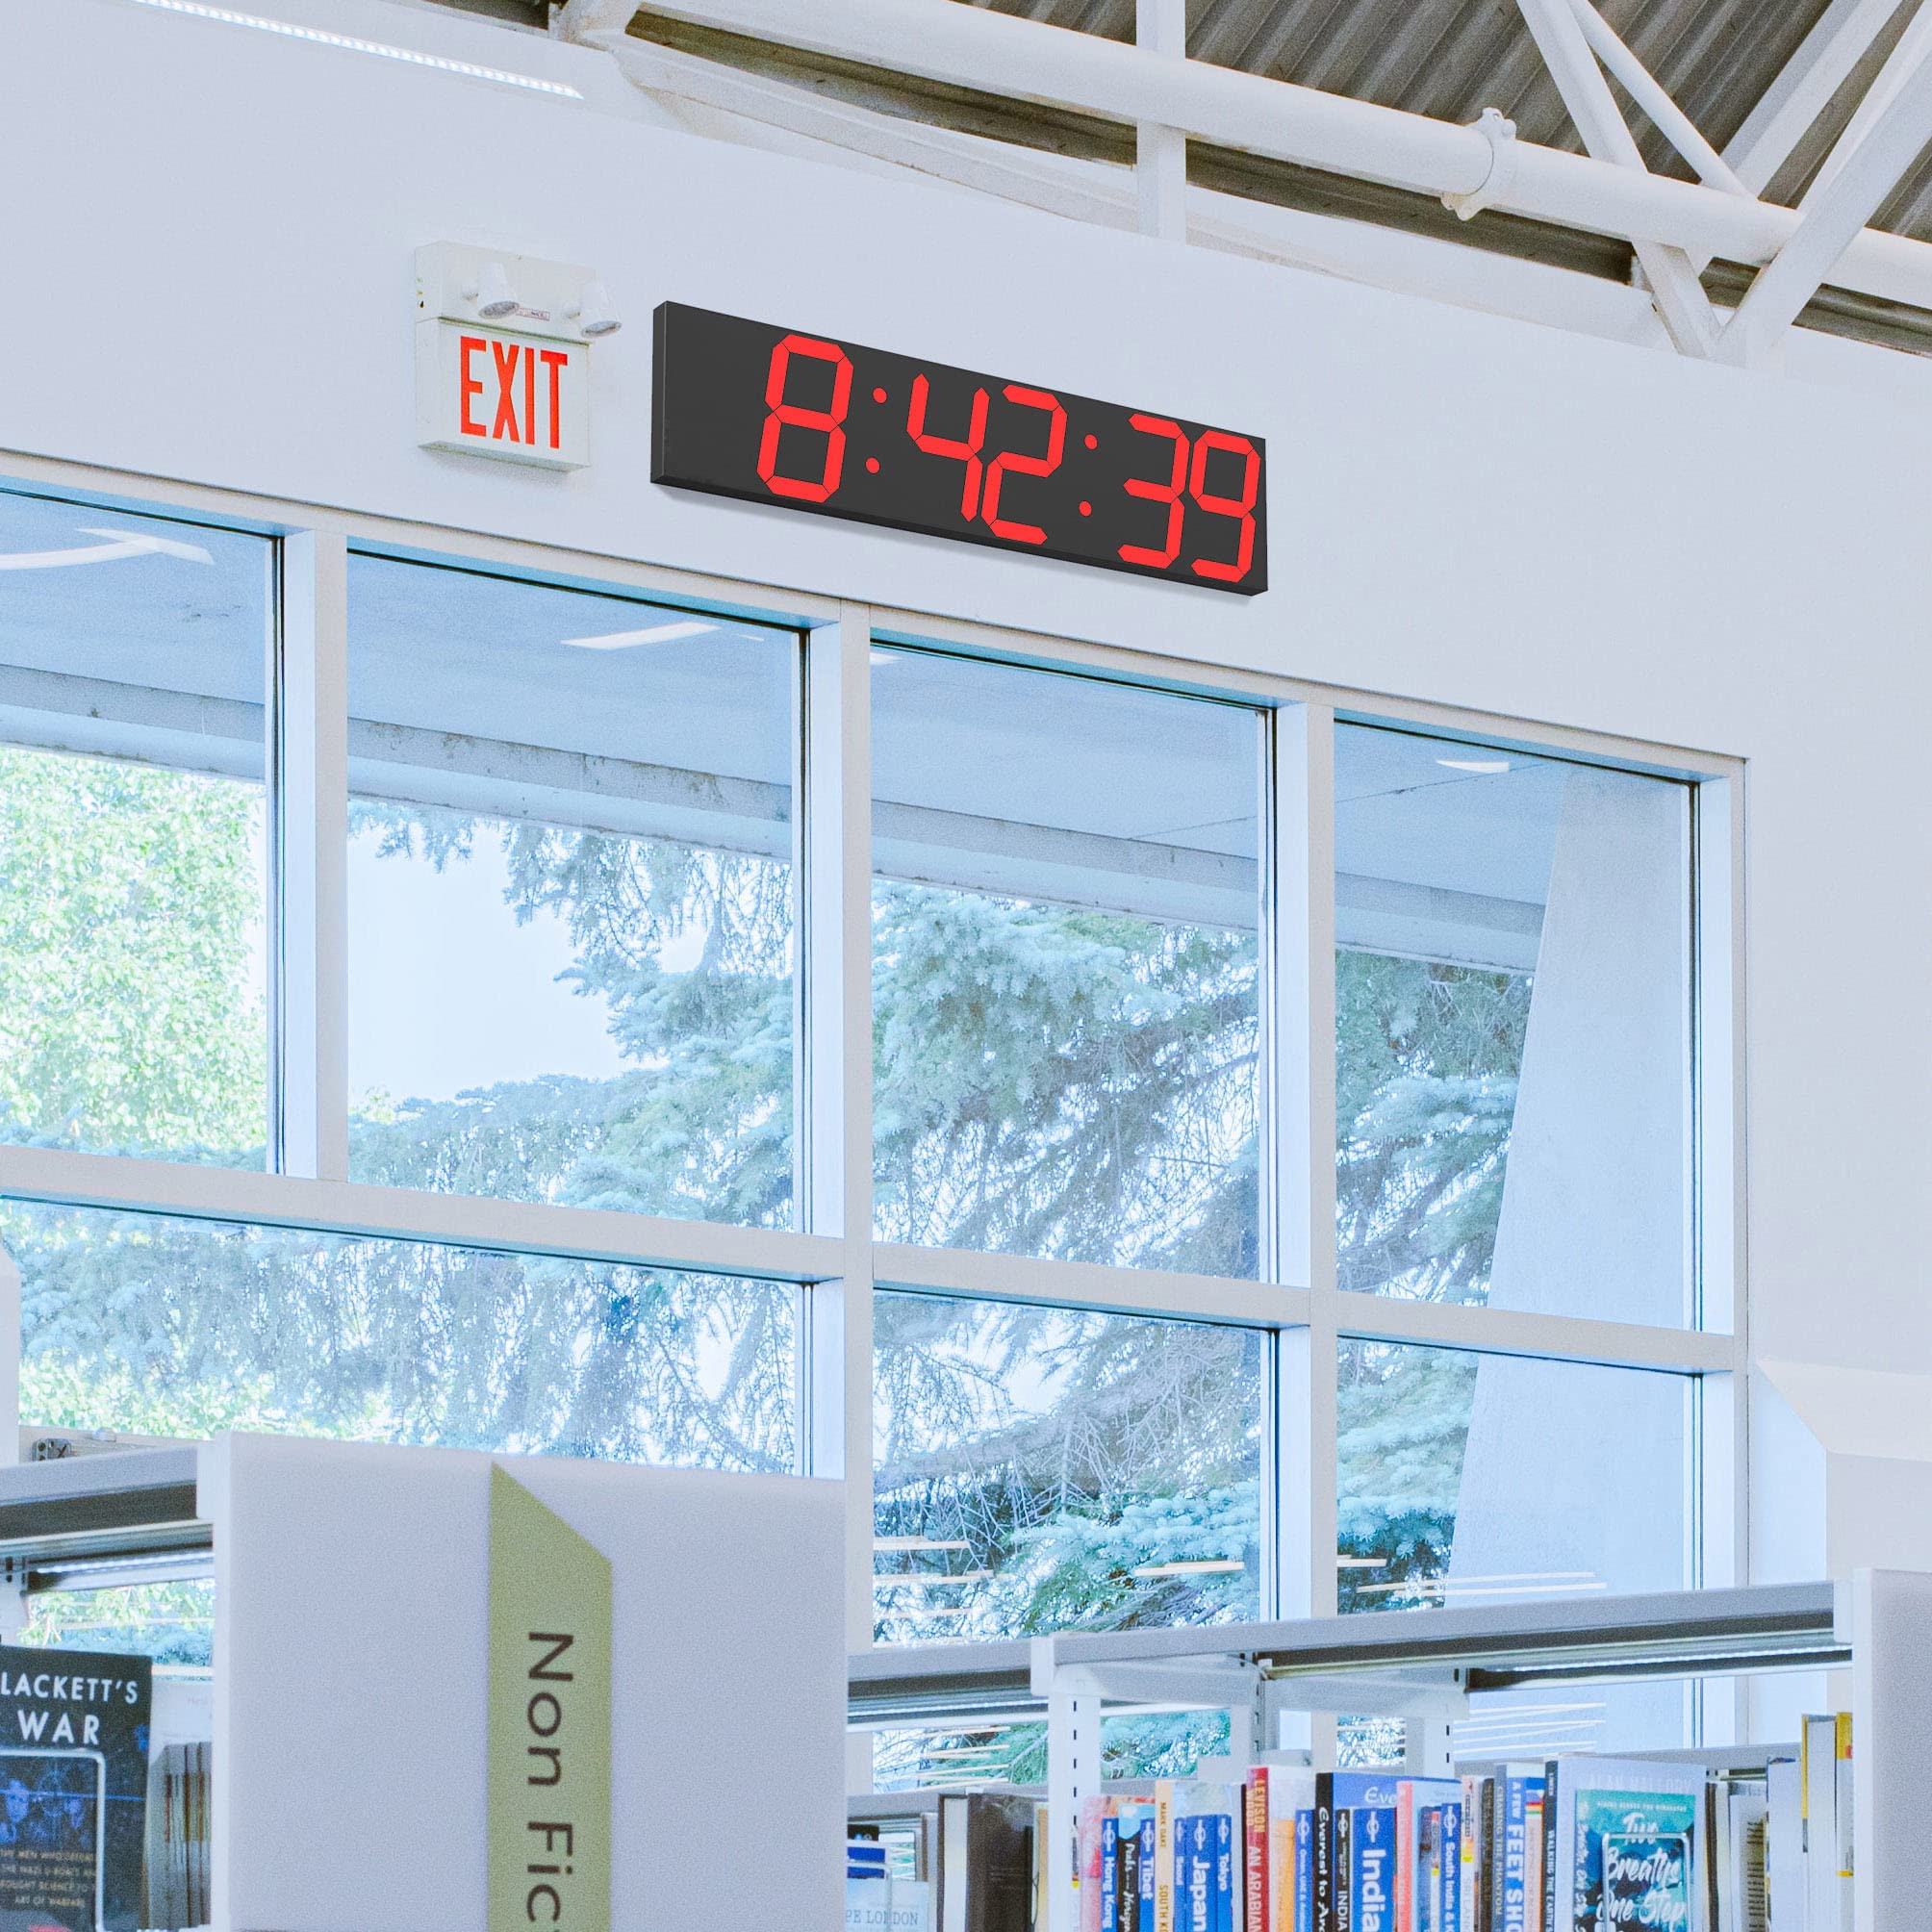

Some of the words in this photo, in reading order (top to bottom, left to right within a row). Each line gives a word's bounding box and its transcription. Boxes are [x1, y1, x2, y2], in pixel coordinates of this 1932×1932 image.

[459, 335, 568, 449] EXIT
[756, 334, 1261, 583] 8:42:39
[0, 1671, 139, 1705] LACKETT'S
[17, 1709, 100, 1745] WAR
[527, 1632, 573, 1786] Non
[1512, 1792, 1522, 1818] FEW
[1513, 1781, 1522, 1791] A
[1254, 1779, 1266, 1833] LEVISON
[1495, 1786, 1504, 1835] CHASING
[1248, 1845, 1260, 1867] AN
[1318, 1807, 1330, 1875] Everest
[1445, 1842, 1456, 1878] South
[1495, 1837, 1504, 1859] THE
[1507, 1824, 1524, 1881] FEET
[1546, 1829, 1555, 1873] WALKING
[526, 1821, 573, 1932] Fic
[1104, 1856, 1115, 1892] Hong
[1142, 1856, 1155, 1900] Tibet
[1176, 1855, 1184, 1886] Seoul
[1218, 1853, 1230, 1892] Tokyo
[1319, 1880, 1329, 1896] to
[1361, 1848, 1386, 1932] India
[1494, 1861, 1503, 1916] PHANTOM
[1104, 1894, 1115, 1929] Kong
[1158, 1885, 1169, 1919] SOUTH
[1189, 1855, 1210, 1932] Japan
[1337, 1891, 1348, 1930] INDIA
[1445, 1880, 1455, 1910] India
[1445, 1912, 1454, 1921] &
